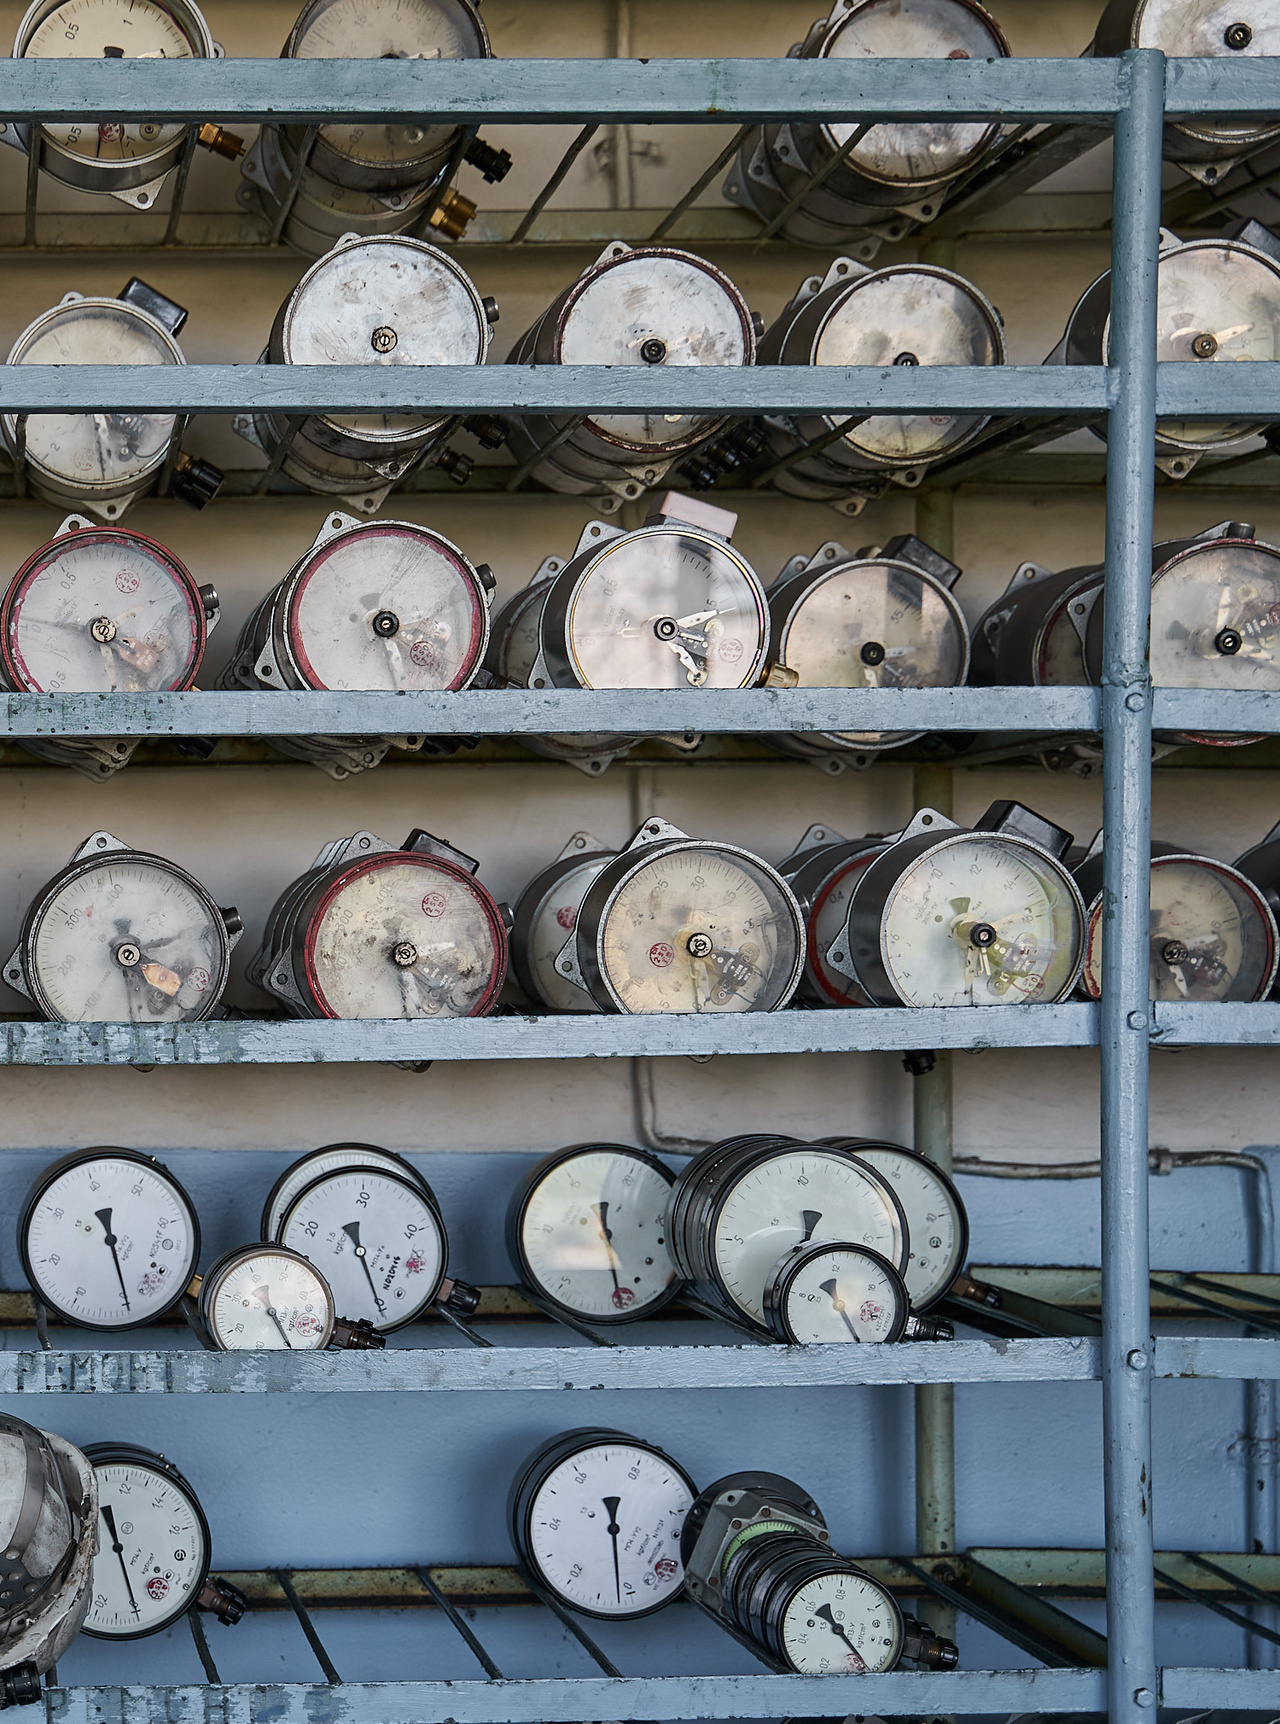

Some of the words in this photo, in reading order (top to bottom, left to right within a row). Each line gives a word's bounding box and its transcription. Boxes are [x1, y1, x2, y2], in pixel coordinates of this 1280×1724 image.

[337, 679, 349, 688] 2
[932, 869, 943, 879] 10
[970, 864, 982, 875] 12
[1003, 880, 1015, 891] 14
[65, 908, 83, 930] 300
[58, 954, 75, 976] 200
[84, 992, 101, 1010] 100
[934, 992, 943, 1001] 2
[660, 1000, 670, 1010] 5
[89, 1181, 100, 1192] 40
[798, 1176, 809, 1187] 10
[131, 1185, 143, 1196] 50
[356, 1192, 370, 1208] 30
[52, 1208, 64, 1219] 30
[926, 1213, 937, 1223] 10
[157, 1217, 169, 1229] 60
[305, 1221, 319, 1237] 20
[404, 1224, 417, 1239] 40
[734, 1235, 744, 1244] 5
[49, 1254, 61, 1265] 20
[832, 1264, 840, 1272] 12
[75, 1286, 87, 1297] 10
[235, 1324, 245, 1333] 20
